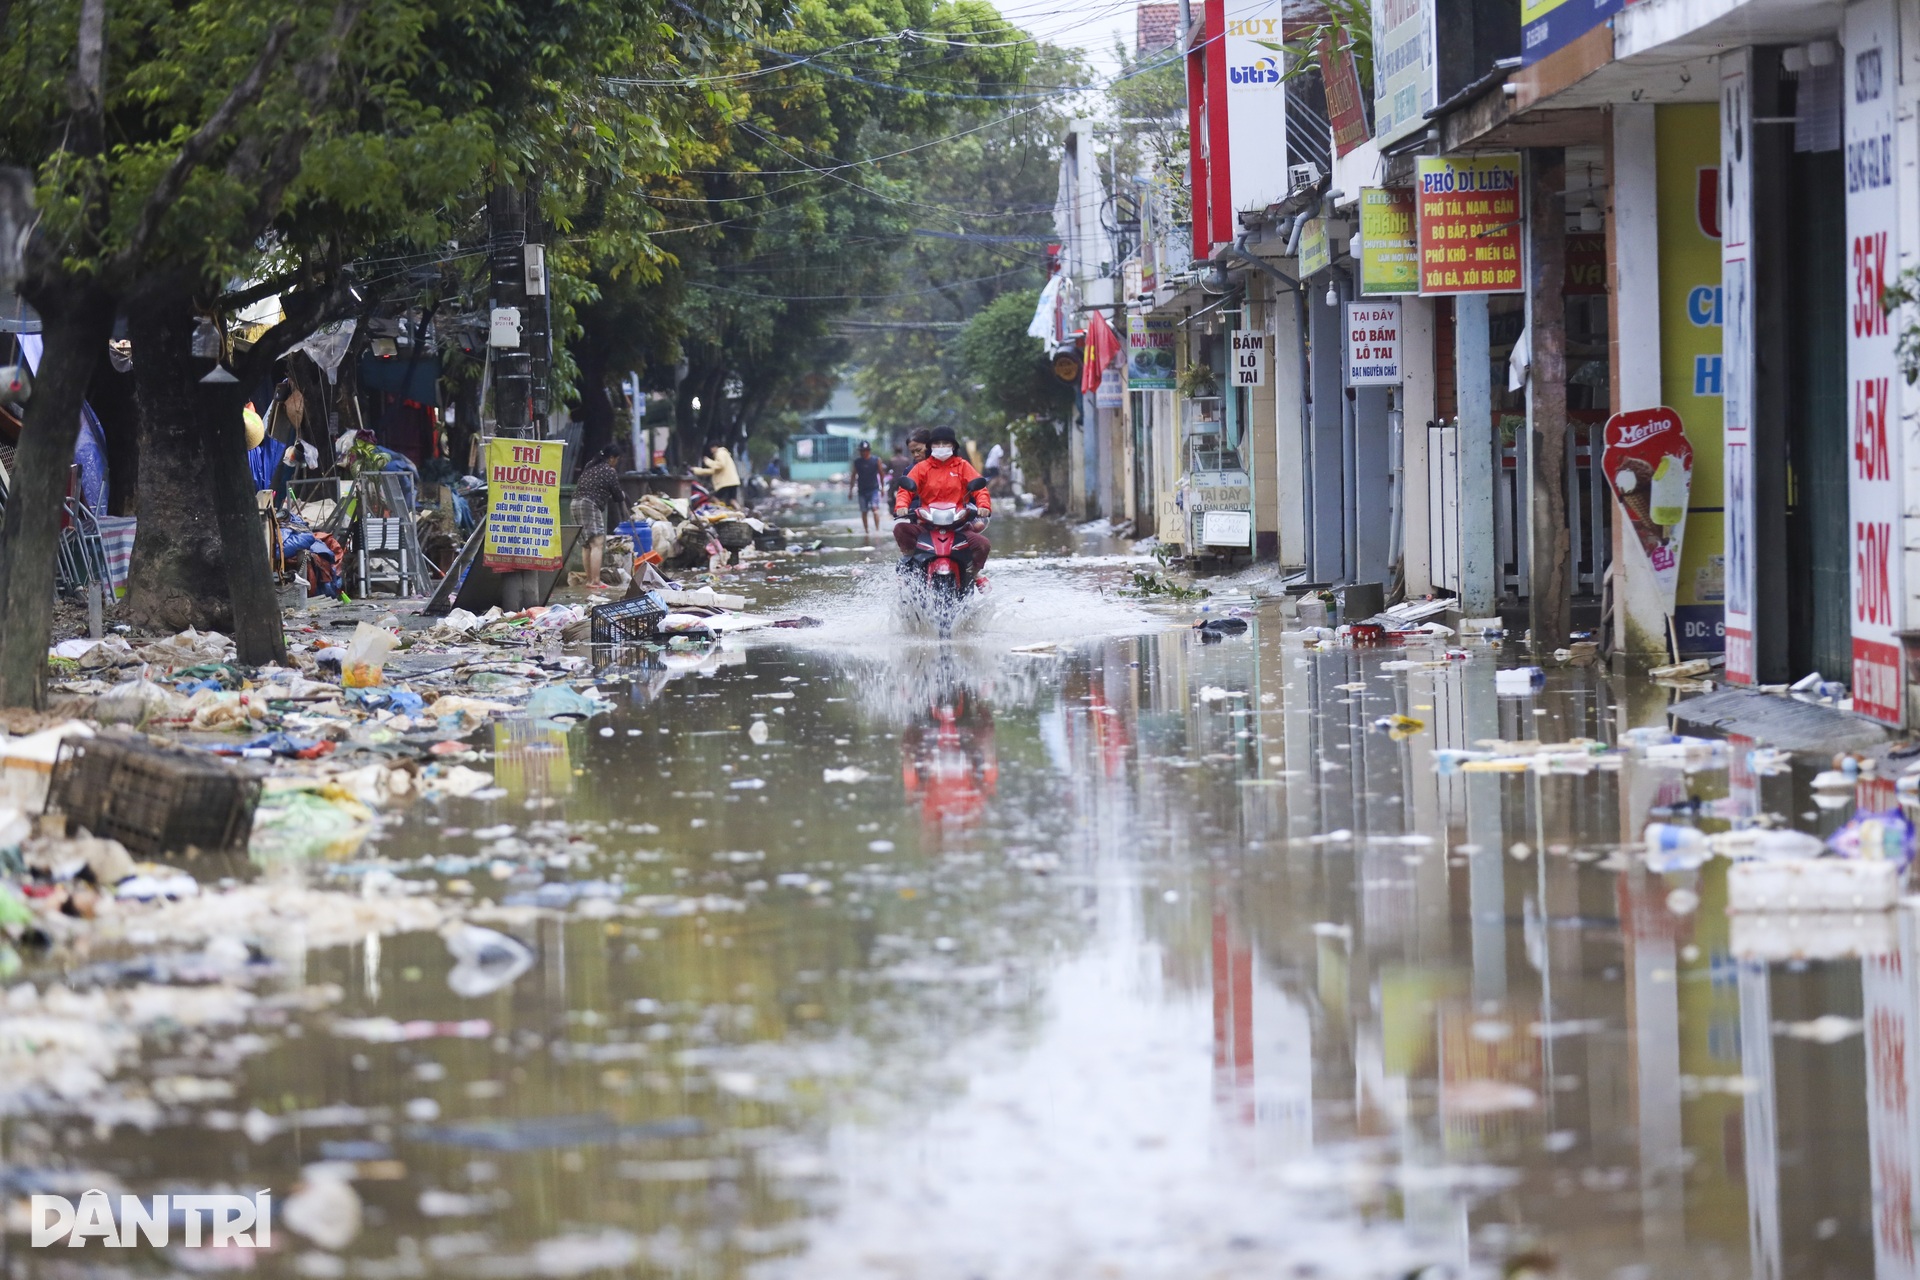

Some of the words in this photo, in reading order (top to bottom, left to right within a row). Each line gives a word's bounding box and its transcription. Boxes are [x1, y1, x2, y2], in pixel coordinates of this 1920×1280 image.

[1228, 18, 1277, 36] HUY
[1424, 164, 1454, 192] PHỞ
[1479, 166, 1514, 191] LIÊN
[1424, 198, 1444, 216] PHỞ
[1446, 199, 1464, 217] TÁI,
[1466, 200, 1492, 218] NẠM,
[1448, 220, 1468, 240] BẮP,
[1426, 244, 1444, 263] PHỞ
[1448, 246, 1466, 262] KHÔ
[1503, 244, 1516, 260] GÀ
[1426, 269, 1442, 286] XÔI
[1463, 268, 1478, 284] XÔI
[1497, 266, 1516, 283] BÓP
[1853, 230, 1888, 338] 35K
[1353, 312, 1369, 323] TẠI
[1372, 308, 1394, 320] ĐÂY
[1130, 332, 1146, 348] NHA
[1149, 332, 1174, 348] TRANG
[1233, 334, 1262, 349] BẤM
[1352, 328, 1366, 342] CÓ
[1369, 326, 1396, 341] BẤM
[1240, 350, 1256, 368] LỖ
[1356, 344, 1370, 360] LỖ
[1374, 347, 1392, 359] TAI
[1618, 418, 1672, 443] Merino
[1854, 376, 1890, 482] 45K
[512, 445, 542, 464] TRÍ
[493, 464, 557, 486] HƯỜNG
[504, 492, 508, 500] Ô
[1220, 486, 1242, 501] ĐÂY
[496, 502, 508, 511] SIÊU
[535, 517, 553, 525] PHANH
[542, 528, 552, 537] LỰC
[526, 547, 530, 555] Ô
[1856, 522, 1892, 627] 50K
[1685, 621, 1710, 638] ĐC:
